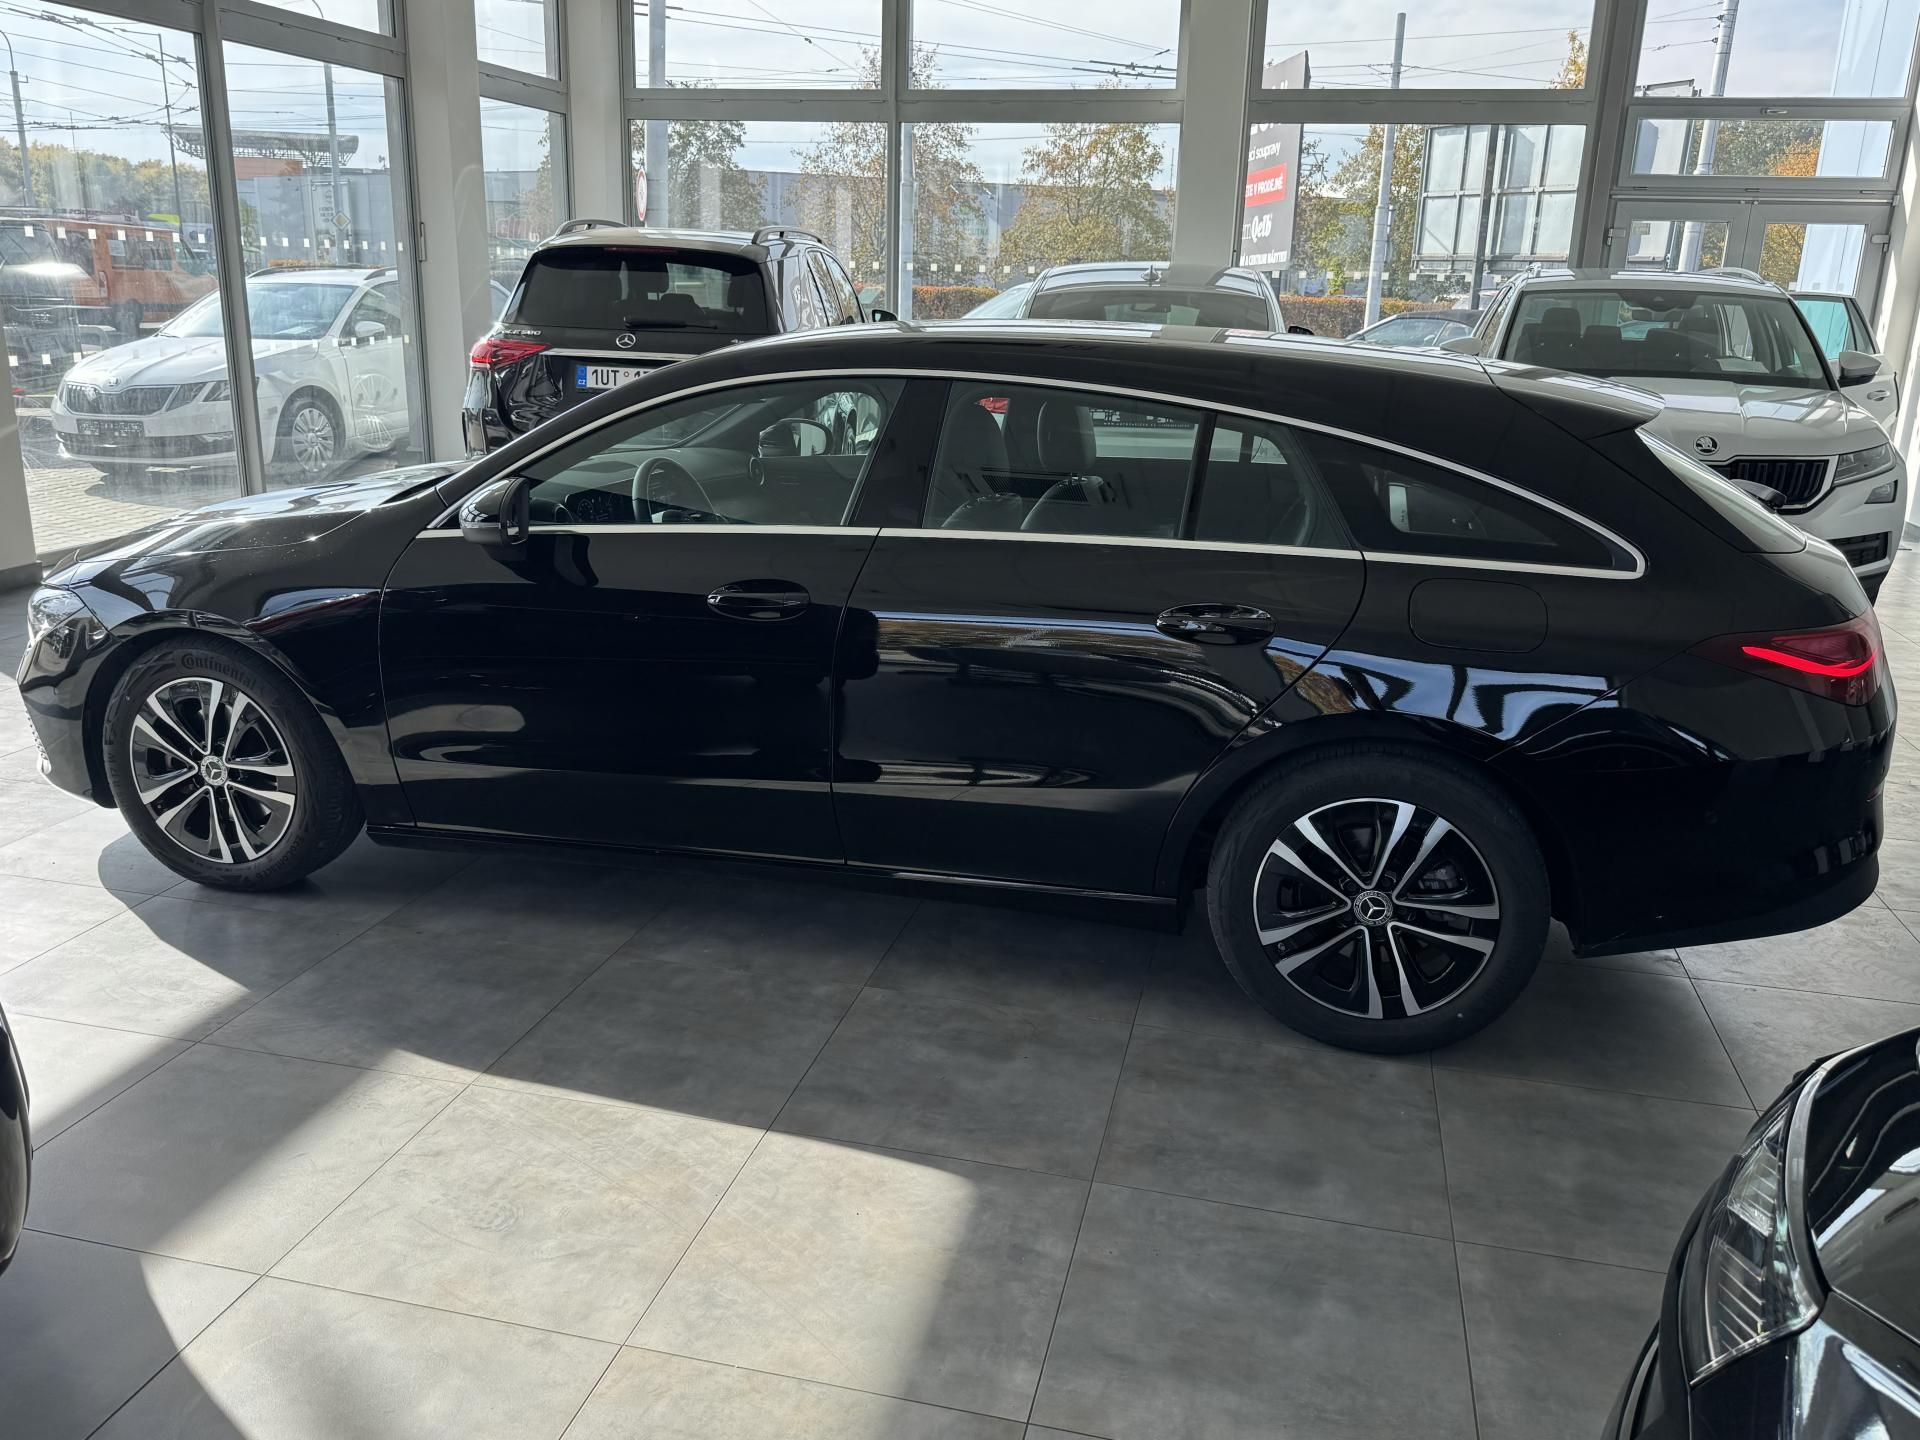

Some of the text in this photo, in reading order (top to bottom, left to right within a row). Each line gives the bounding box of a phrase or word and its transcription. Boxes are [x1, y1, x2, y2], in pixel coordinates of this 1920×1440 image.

[1256, 141, 1281, 160] soupravy
[591, 369, 620, 387] 1UT
[181, 653, 257, 689] Continental
